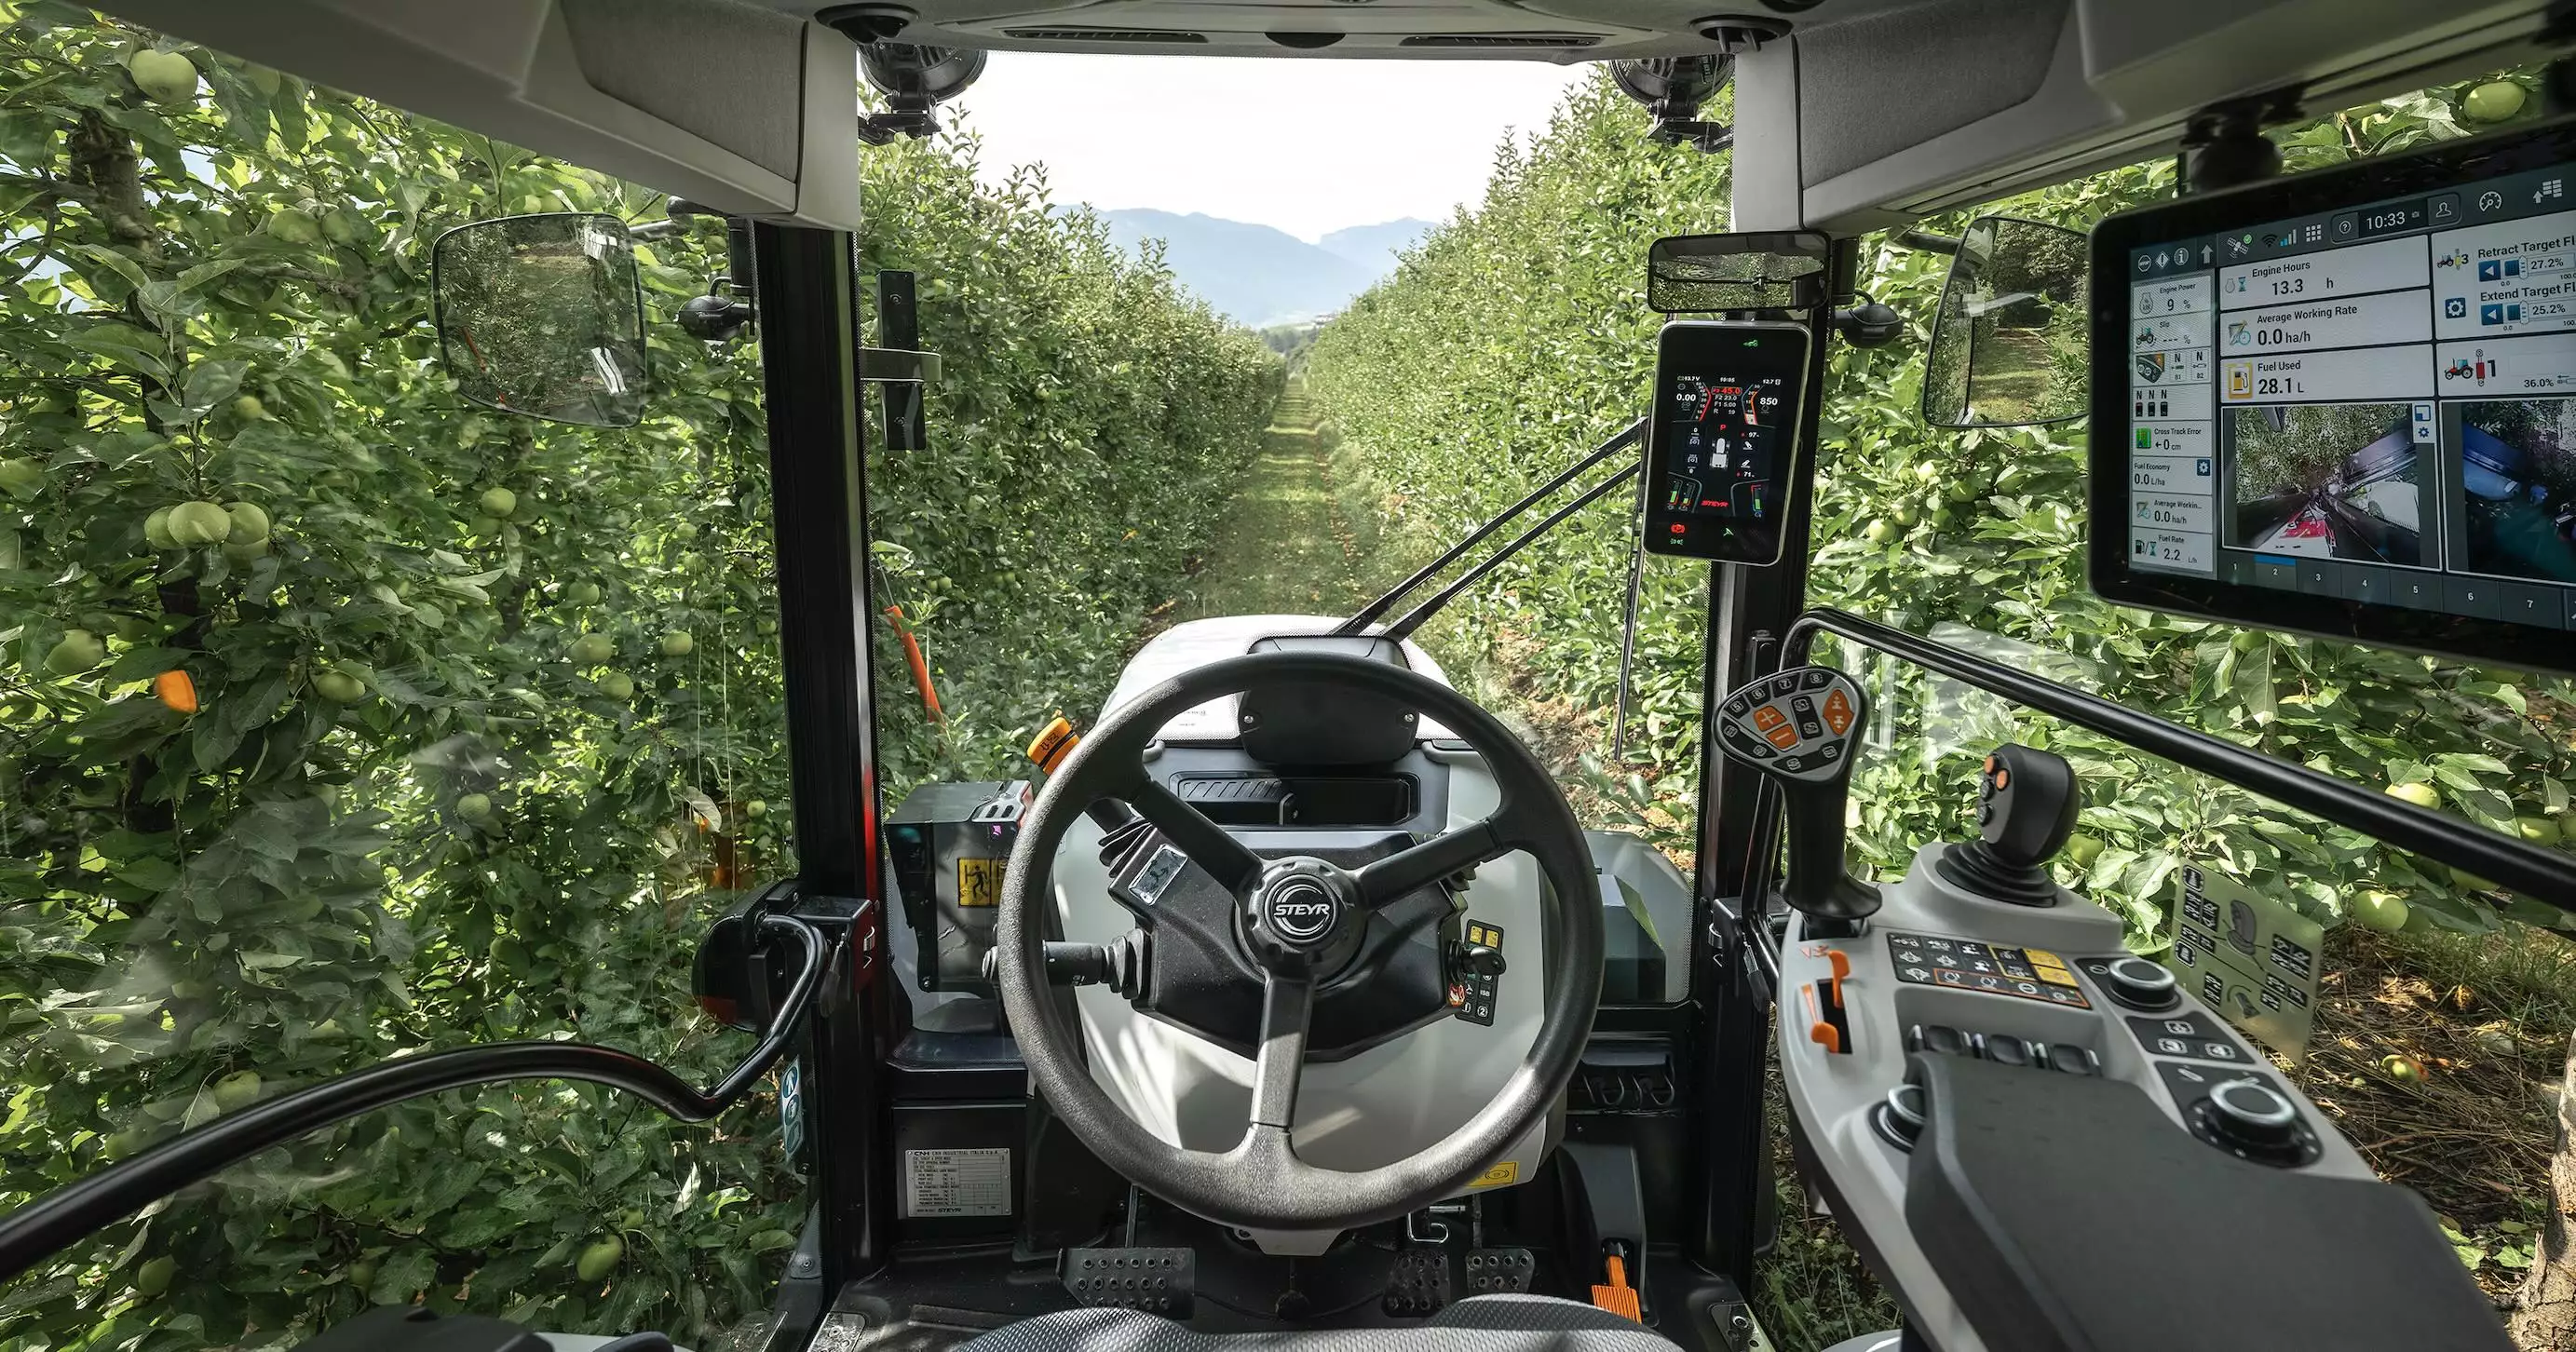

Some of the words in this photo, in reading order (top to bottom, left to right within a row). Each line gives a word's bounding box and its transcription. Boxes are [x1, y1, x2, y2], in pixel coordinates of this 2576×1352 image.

[2366, 211, 2406, 230] 10:33
[2478, 245, 2518, 258] Retract
[2521, 238, 2560, 251] Target
[2461, 253, 2468, 264] 3
[2531, 258, 2563, 269] 27.2%
[2252, 266, 2281, 277] Engine
[2284, 262, 2311, 273] Hours
[2272, 278, 2303, 295] 13.3
[2326, 277, 2334, 289] h
[2480, 288, 2519, 302] Extend
[2521, 285, 2561, 297] Target
[2167, 299, 2175, 311] 9
[2532, 304, 2566, 315] 25.2%
[2257, 313, 2292, 324] Average
[2294, 308, 2332, 319] Working
[2336, 304, 2357, 317] Rate
[2257, 329, 2283, 345] 0.0
[2285, 331, 2311, 345] ha/h
[2175, 353, 2180, 362] N
[2197, 351, 2203, 360] N
[2257, 362, 2276, 372] Fuel
[2279, 360, 2301, 371] Used
[2487, 359, 2496, 377] 1
[2258, 378, 2292, 395] 28.1
[2298, 382, 2304, 393] L
[2524, 378, 2554, 388] 36.0%
[2136, 390, 2142, 399] N
[2149, 390, 2155, 399] N
[2162, 389, 2167, 399] N
[1759, 398, 1778, 406] 850
[2146, 464, 2170, 472] Economy
[2134, 473, 2149, 485] 0.0
[2150, 478, 2165, 486] L/ha
[2154, 500, 2176, 509] Average
[2154, 511, 2171, 522] 0.0
[2172, 516, 2187, 524] ha/h
[2159, 534, 2170, 543] Fuel
[2163, 548, 2180, 561] 2.2
[2315, 573, 2321, 581] 3
[2362, 579, 2368, 588] 4
[2413, 586, 2419, 594] 5
[2468, 592, 2474, 601] 6
[2527, 600, 2533, 608] 7
[1273, 903, 1330, 915] STEYR
